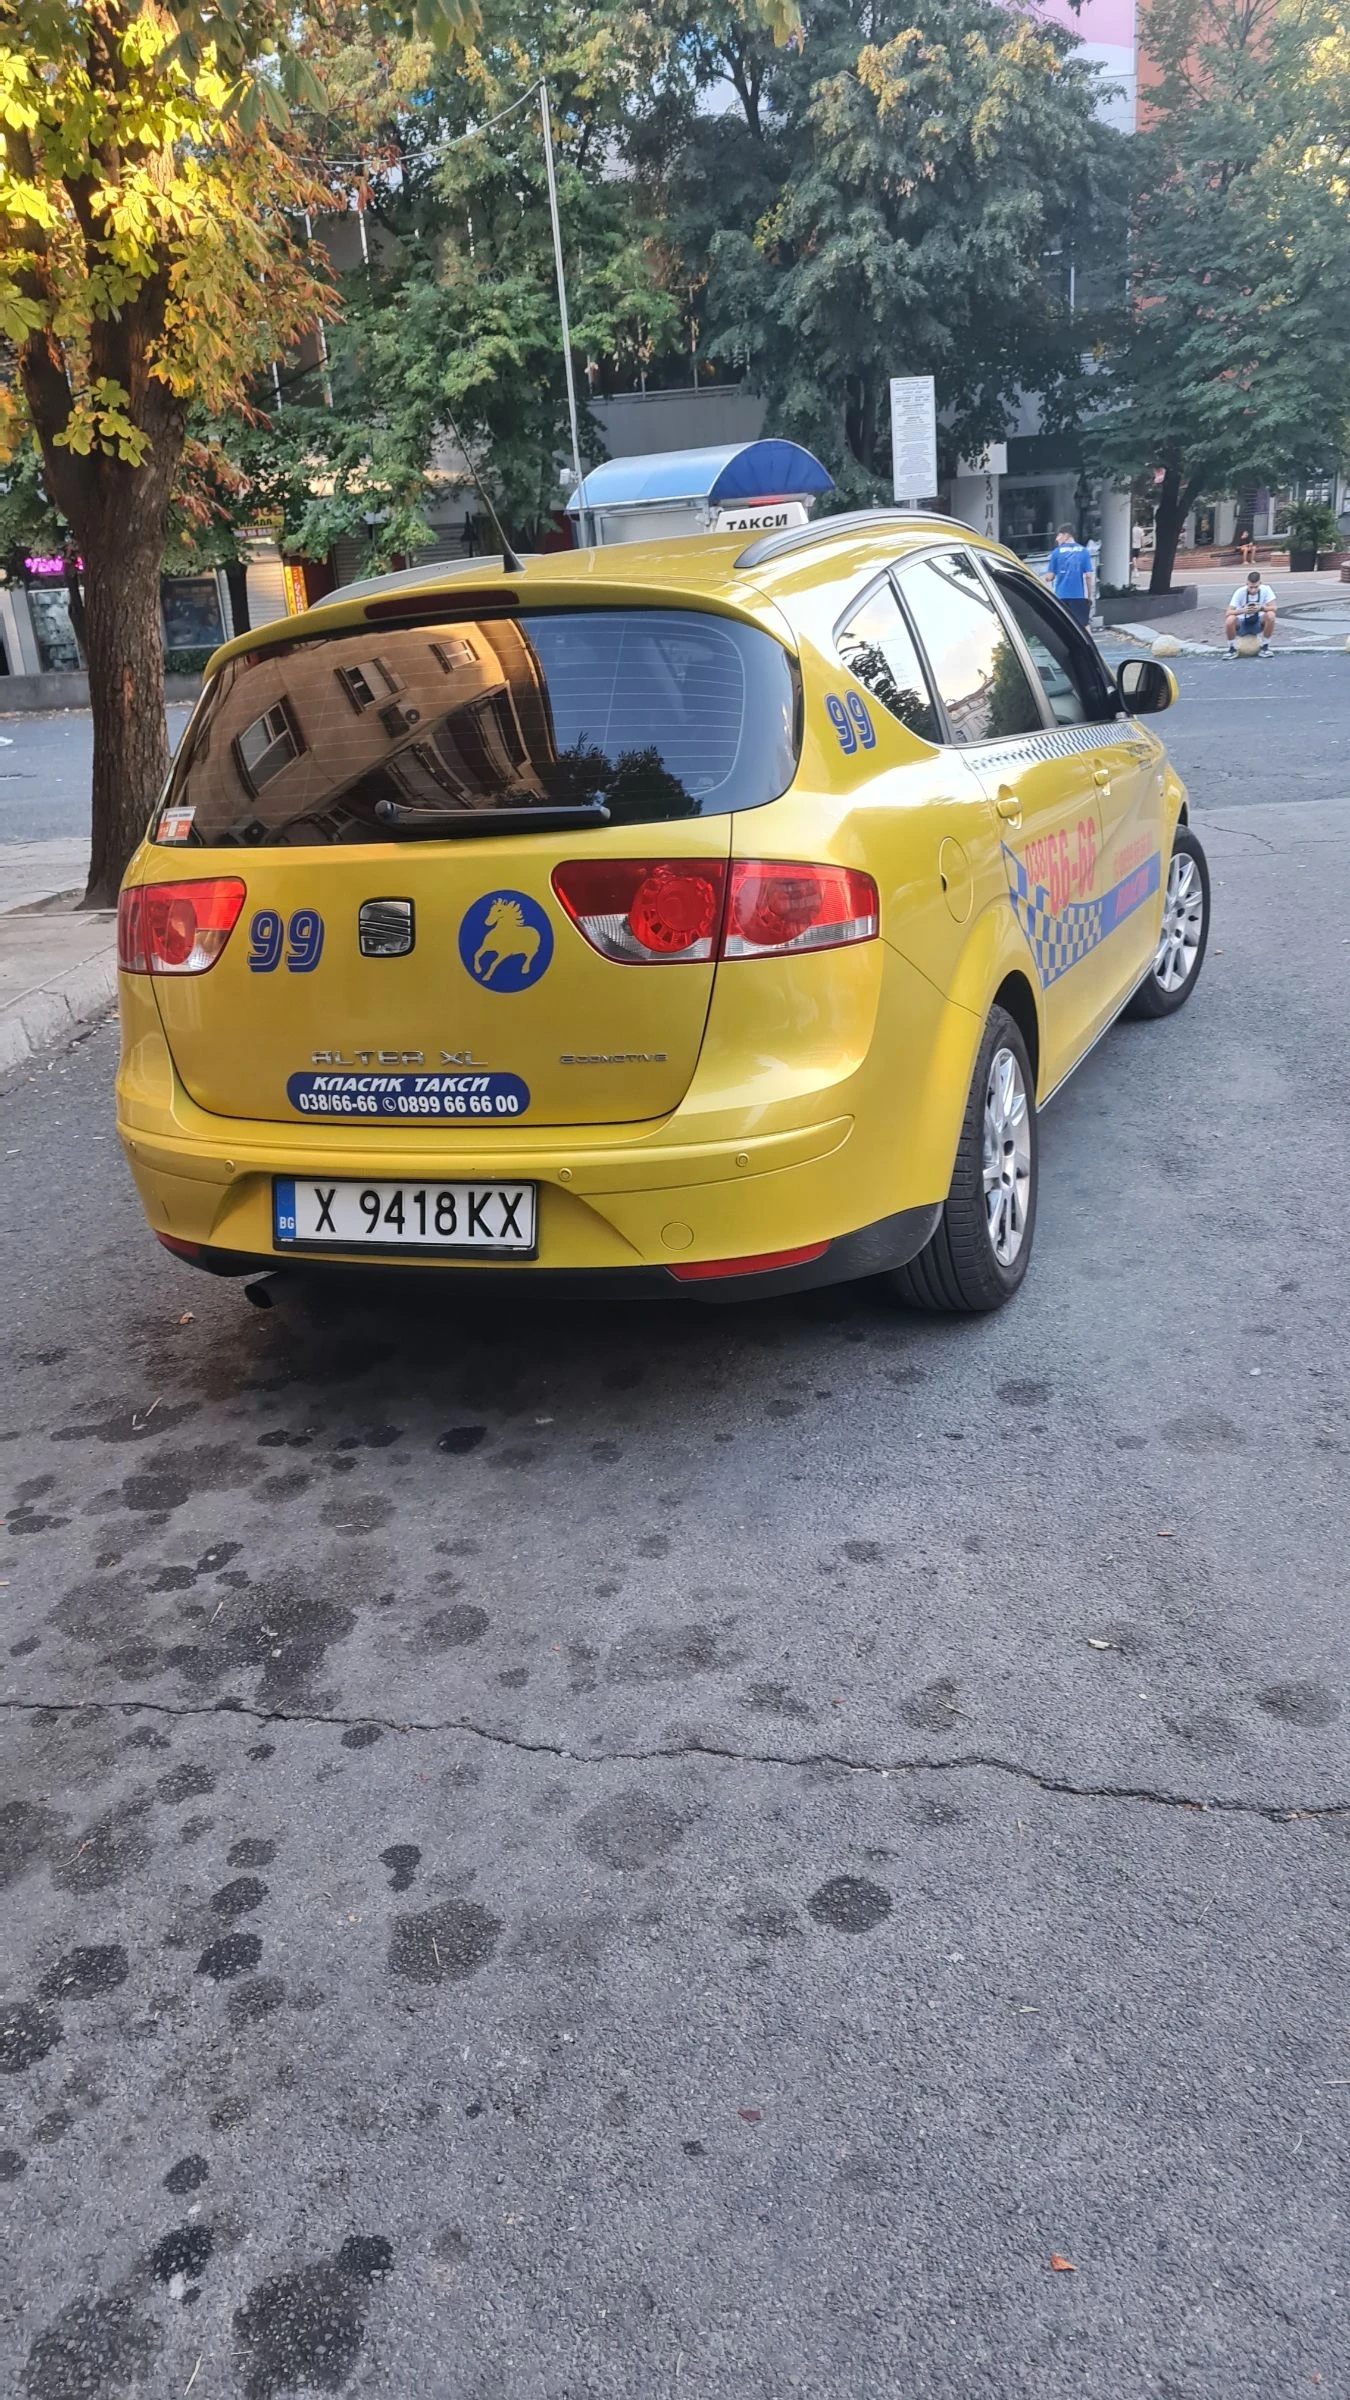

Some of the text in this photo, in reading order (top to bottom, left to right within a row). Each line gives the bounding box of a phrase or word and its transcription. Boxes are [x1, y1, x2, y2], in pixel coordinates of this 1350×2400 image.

[726, 513, 788, 530] ТАКСИ
[824, 689, 876, 756] 99
[247, 908, 325, 973] 99
[311, 1050, 489, 1066] ALTEA XL
[312, 1076, 491, 1092] КЛАСИК ТАКСИ
[299, 1093, 519, 1114] 038/66-66 0899 66 66 00
[279, 1216, 295, 1230] BG
